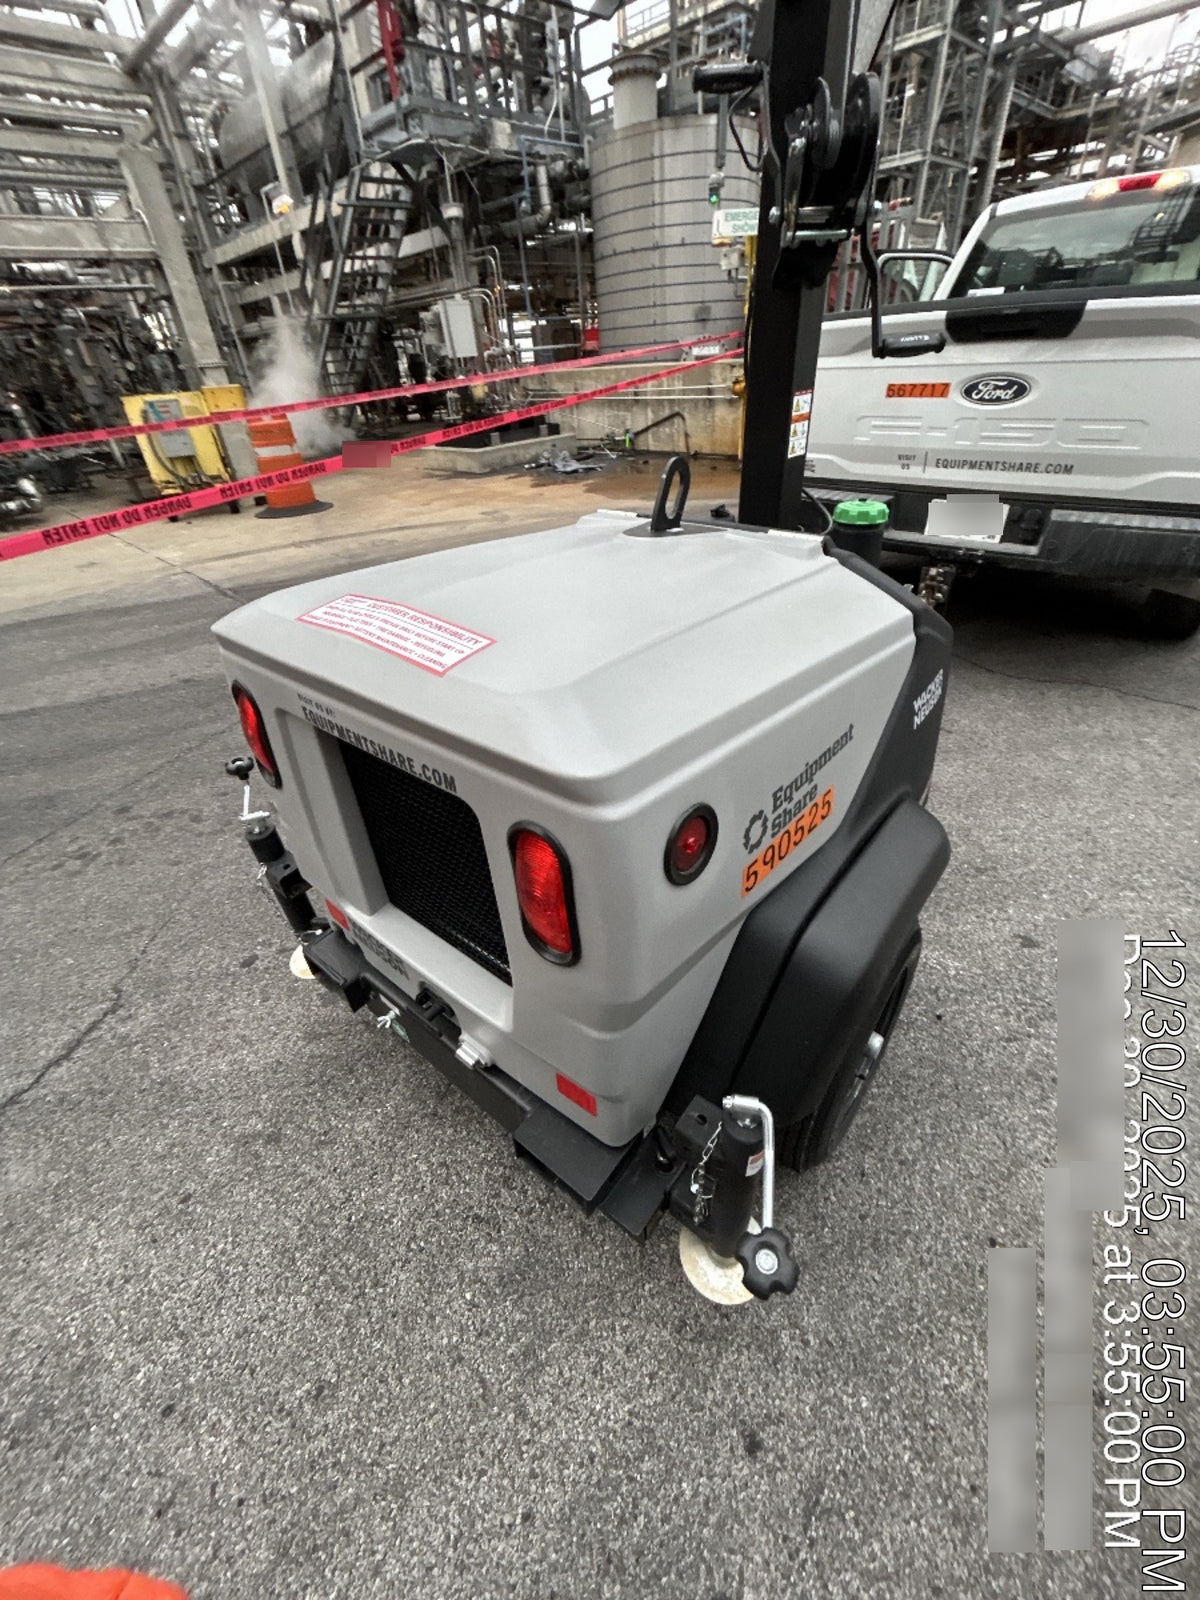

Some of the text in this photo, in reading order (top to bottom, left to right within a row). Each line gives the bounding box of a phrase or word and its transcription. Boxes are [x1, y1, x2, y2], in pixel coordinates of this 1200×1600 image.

[886, 383, 950, 398] 567717
[970, 379, 1019, 401] Ford
[935, 457, 1075, 475] EQUIPMENTSHARE.COM
[408, 611, 482, 645] RESPONSIBILITY
[301, 705, 458, 794] EQUIPMENTSHARE.COM
[771, 723, 855, 814] Equipment
[770, 783, 819, 838] Share
[744, 788, 833, 893] 590525
